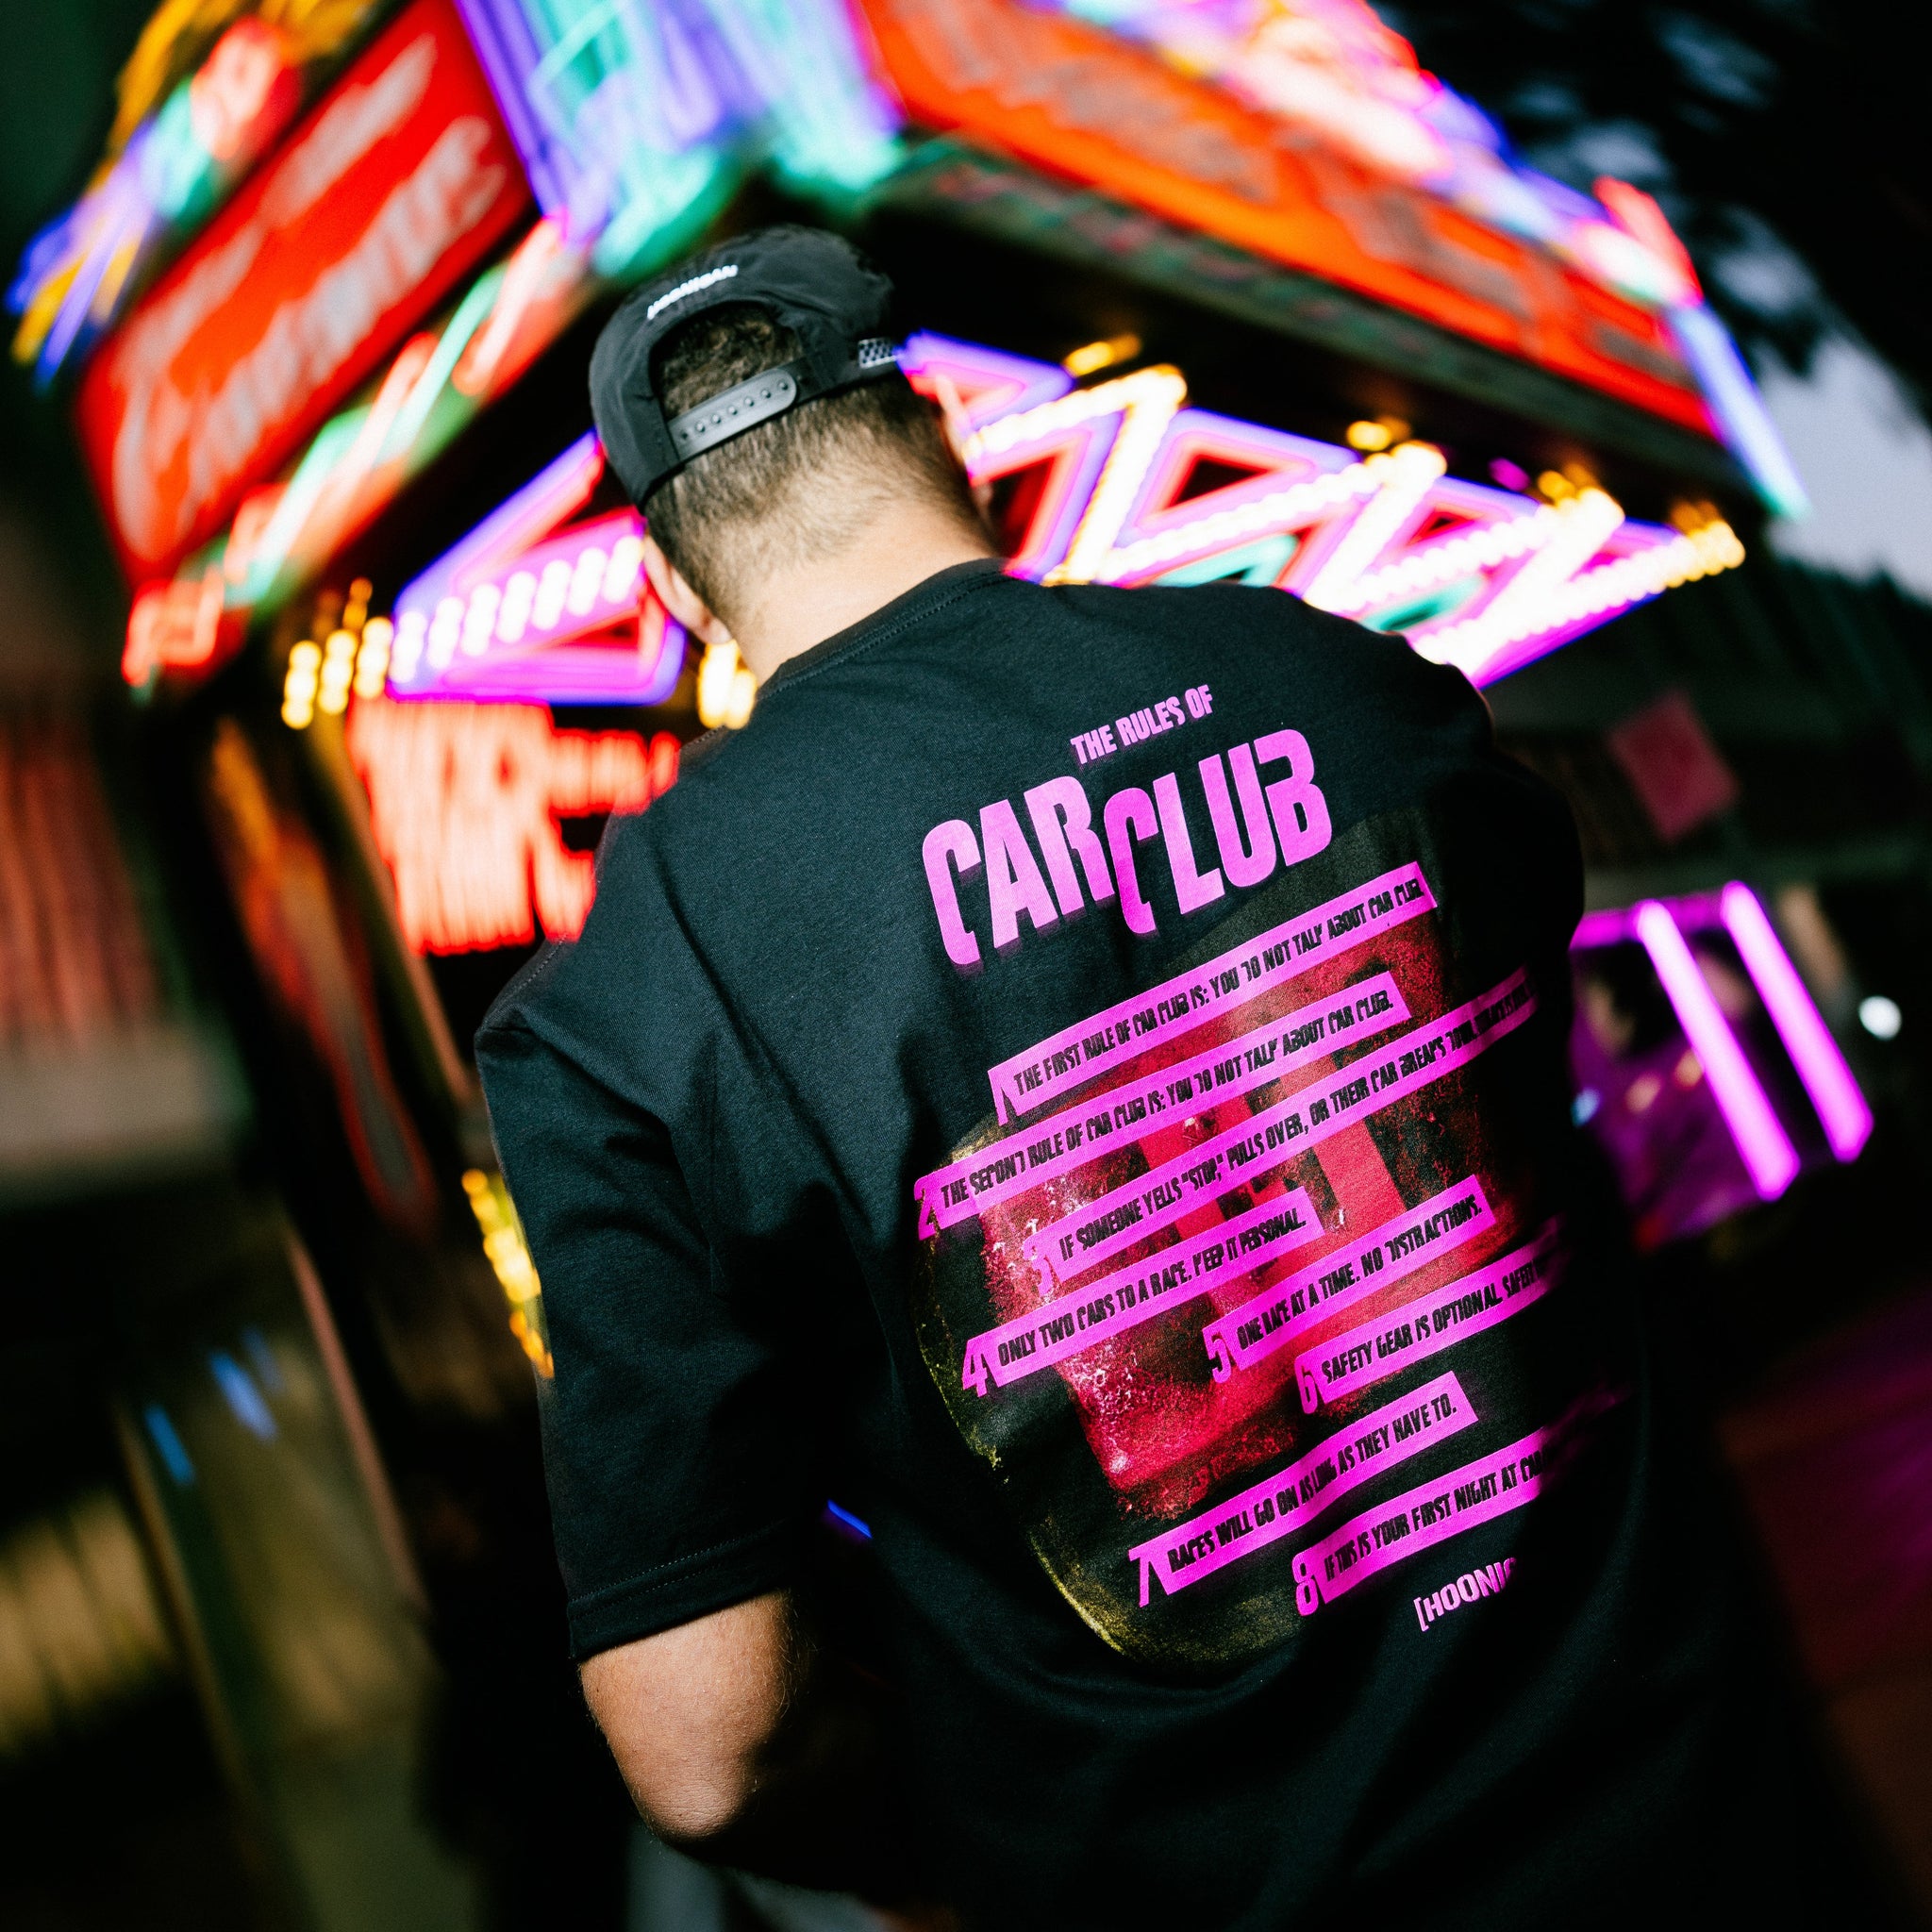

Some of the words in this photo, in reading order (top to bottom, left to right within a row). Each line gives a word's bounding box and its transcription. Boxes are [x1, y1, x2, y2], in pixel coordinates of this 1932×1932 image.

[1070, 725, 1117, 765] THE
[1115, 695, 1186, 747] RULES
[1184, 684, 1213, 720] OF
[922, 775, 1115, 965] CAR
[1103, 728, 1332, 934] CLUB
[1013, 1064, 1043, 1095] THE
[1042, 1044, 1083, 1081] FIRST
[1082, 1026, 1116, 1061] RULE
[1114, 1018, 1132, 1045] OF
[1131, 1008, 1158, 1036] CAR
[1157, 991, 1191, 1026] CLUB
[1190, 984, 1211, 1009] IS:
[1208, 967, 1241, 999] YOU
[1262, 939, 1293, 973] NOT
[1291, 923, 1325, 956] TALK
[1326, 903, 1369, 941] ABOUT
[1368, 890, 1395, 920] CAR
[941, 1177, 970, 1208] THE
[1026, 1132, 1064, 1169] RULE
[1064, 1124, 1085, 1152] OF
[1086, 1111, 1114, 1142] CAR
[1113, 1094, 1147, 1129] CLUB
[1146, 1089, 1167, 1115] IS:
[1164, 1077, 1193, 1107] YOU
[1213, 1055, 1243, 1087] NOT
[1243, 1038, 1278, 1073] TALK
[1282, 1016, 1326, 1057] ABOUT
[1327, 1005, 1356, 1035] CAR
[1356, 990, 1394, 1022] CLUB.
[1058, 1234, 1074, 1261] IF
[1074, 1198, 1145, 1251] SOMEONE
[1143, 1176, 1183, 1216] YELLS
[1226, 1132, 1265, 1171] PULLS
[1264, 1112, 1309, 1150] OVER,
[1308, 1097, 1331, 1126] OR
[1329, 1076, 1371, 1114] THEIR
[1370, 1061, 1399, 1093] CAR
[1398, 1036, 1448, 1078] BREAKS
[962, 1340, 989, 1397] 4
[997, 1329, 1040, 1367] ONLY
[1039, 1312, 1076, 1348] TWO
[1075, 1294, 1116, 1331] CARS
[1115, 1284, 1137, 1311] TO
[1137, 1277, 1151, 1302] A
[1149, 1260, 1193, 1298] RACE.
[1192, 1242, 1225, 1276] KEEP
[1225, 1238, 1240, 1262] IT
[1238, 1208, 1307, 1256] PERSONAL.
[1202, 1326, 1232, 1383] 5
[1236, 1320, 1264, 1350] ONE
[1262, 1299, 1291, 1333] RACE
[1290, 1288, 1307, 1318] AT
[1307, 1283, 1321, 1308] A
[1319, 1261, 1361, 1301] TIME.
[1360, 1247, 1385, 1274] NO
[1293, 1356, 1318, 1414] 6
[1321, 1341, 1374, 1384] SAFETY
[1376, 1323, 1414, 1359] GEAR
[1414, 1314, 1432, 1342] IS
[1128, 1548, 1151, 1607] 7
[1167, 1530, 1215, 1574] RACES
[1214, 1510, 1254, 1547] WILL
[1253, 1497, 1276, 1527] GO
[1275, 1485, 1300, 1516] ON
[1298, 1475, 1314, 1505] AS
[1312, 1457, 1338, 1494] LONG
[1337, 1445, 1357, 1475] AS
[1355, 1424, 1391, 1463] THEY
[1391, 1404, 1432, 1443] HAVE
[1430, 1392, 1457, 1422] TO.
[1291, 1553, 1319, 1617] 8
[1324, 1557, 1337, 1582] IF
[1336, 1539, 1358, 1574] THIS
[1357, 1532, 1373, 1559] IS
[1371, 1513, 1412, 1550] YOUR
[1412, 1494, 1452, 1532] FIRST
[1454, 1472, 1498, 1513] NIGHT
[1501, 1465, 1520, 1492] AT
